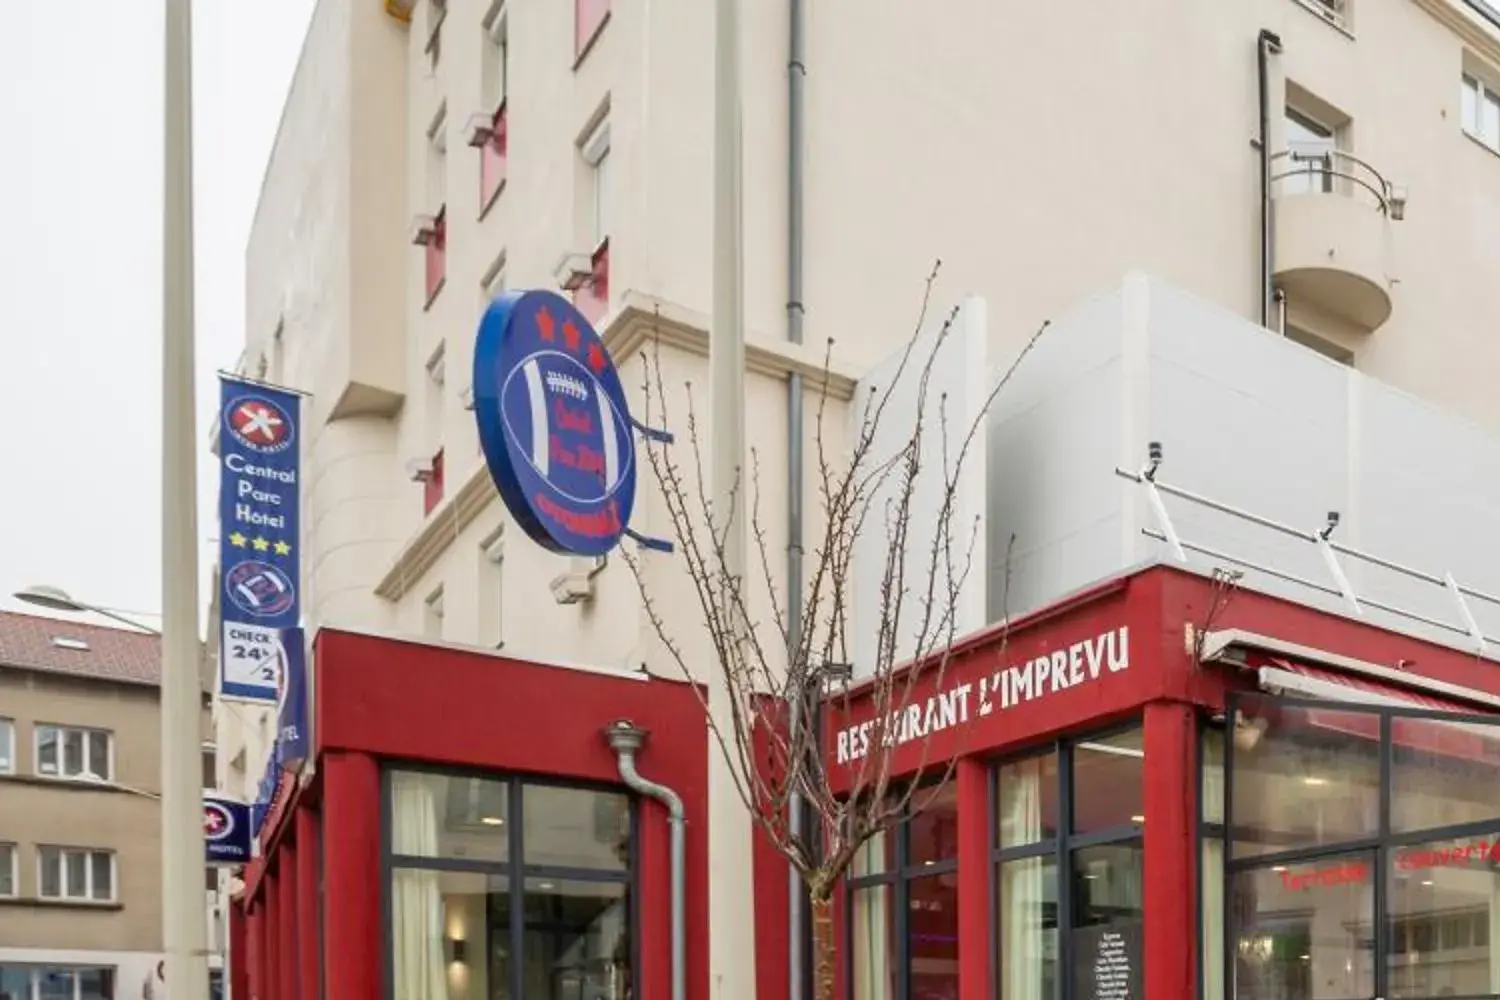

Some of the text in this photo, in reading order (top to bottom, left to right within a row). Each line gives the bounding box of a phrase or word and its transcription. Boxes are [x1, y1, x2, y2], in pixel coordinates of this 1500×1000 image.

[224, 453, 296, 483] Central
[238, 479, 281, 505] Parc
[837, 625, 1129, 765] RESAURANT L'IMPREVU
